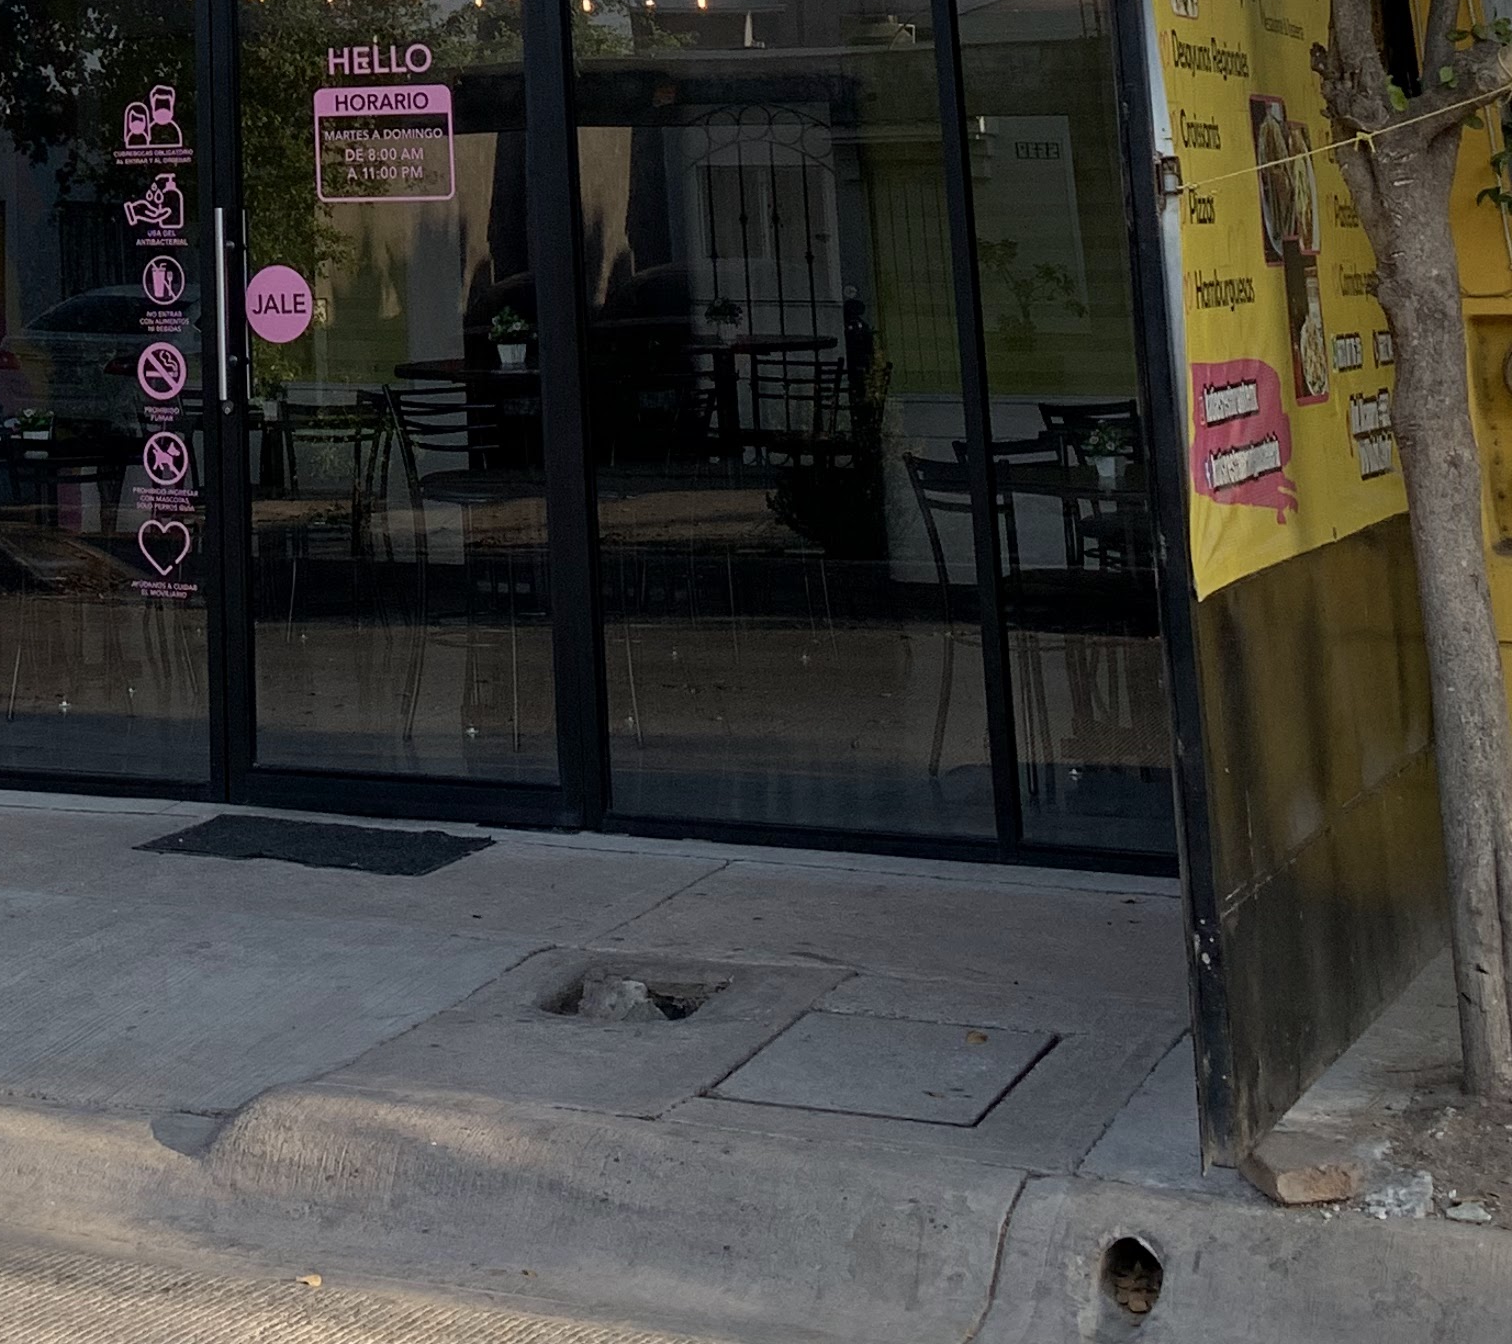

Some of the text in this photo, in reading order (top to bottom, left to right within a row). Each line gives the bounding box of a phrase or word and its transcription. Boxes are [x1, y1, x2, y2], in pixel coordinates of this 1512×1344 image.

[327, 43, 432, 75] HELLO
[335, 92, 429, 112] HORARIO
[324, 128, 443, 141] MARTES A DOMINGO
[345, 147, 424, 162] DE 8:00 AM
[347, 166, 423, 180] A 11:00 PM
[136, 238, 188, 246] ANTIBACTERIAL
[252, 293, 306, 314] JALE
